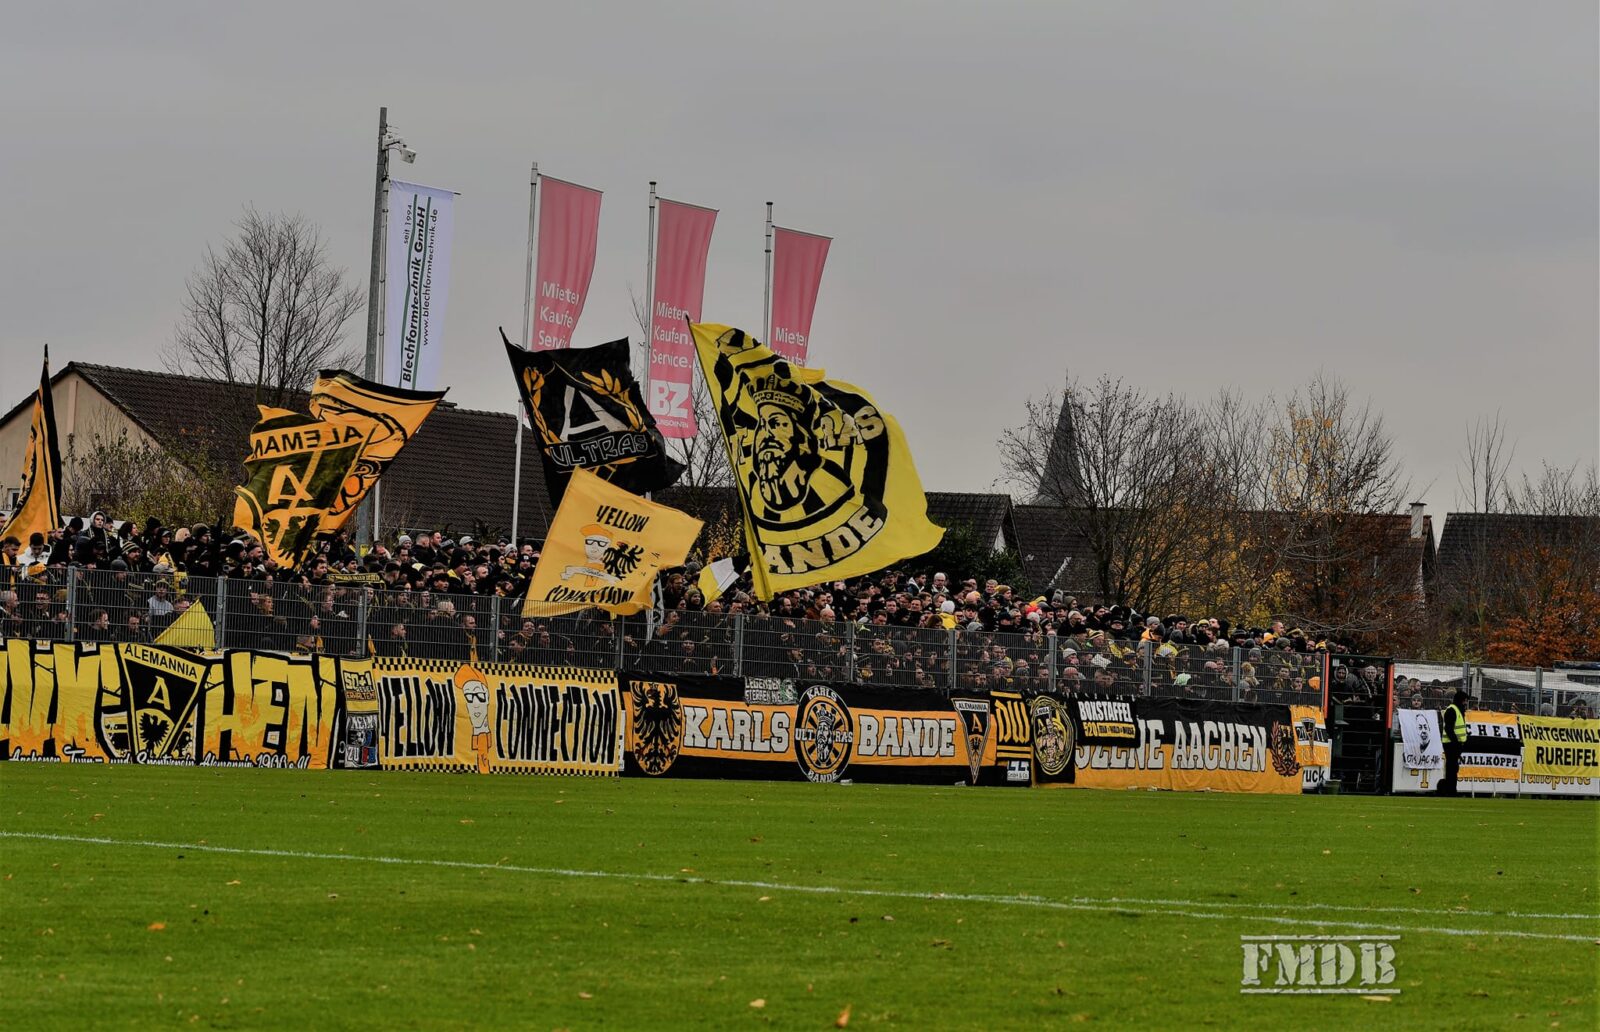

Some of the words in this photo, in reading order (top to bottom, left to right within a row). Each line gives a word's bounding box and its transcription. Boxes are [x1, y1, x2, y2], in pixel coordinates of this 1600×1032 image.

[405, 204, 413, 227] 1994
[423, 208, 438, 346] www.blechformtechnik.de
[403, 257, 422, 383] Blechformtechnik
[414, 206, 426, 253] GmbH
[653, 325, 694, 346] Kaufen.
[652, 348, 693, 368] Service.
[650, 379, 690, 419] BZ
[549, 433, 648, 467] ULTRAS
[596, 505, 650, 533] YELLOW
[125, 645, 198, 678] ALEMANNIA
[807, 687, 837, 701] KARLS
[958, 703, 988, 711] ALEMANNIA
[377, 677, 456, 758] YELLOW
[496, 682, 618, 764] CONNECTION
[1078, 700, 1133, 723] BOXSTAFFEL
[683, 704, 791, 753] KARLS
[858, 715, 956, 758] BANDE
[1172, 720, 1267, 772] AACHEN
[1536, 746, 1598, 767] RUREIFEL
[808, 770, 839, 783] BANDE
